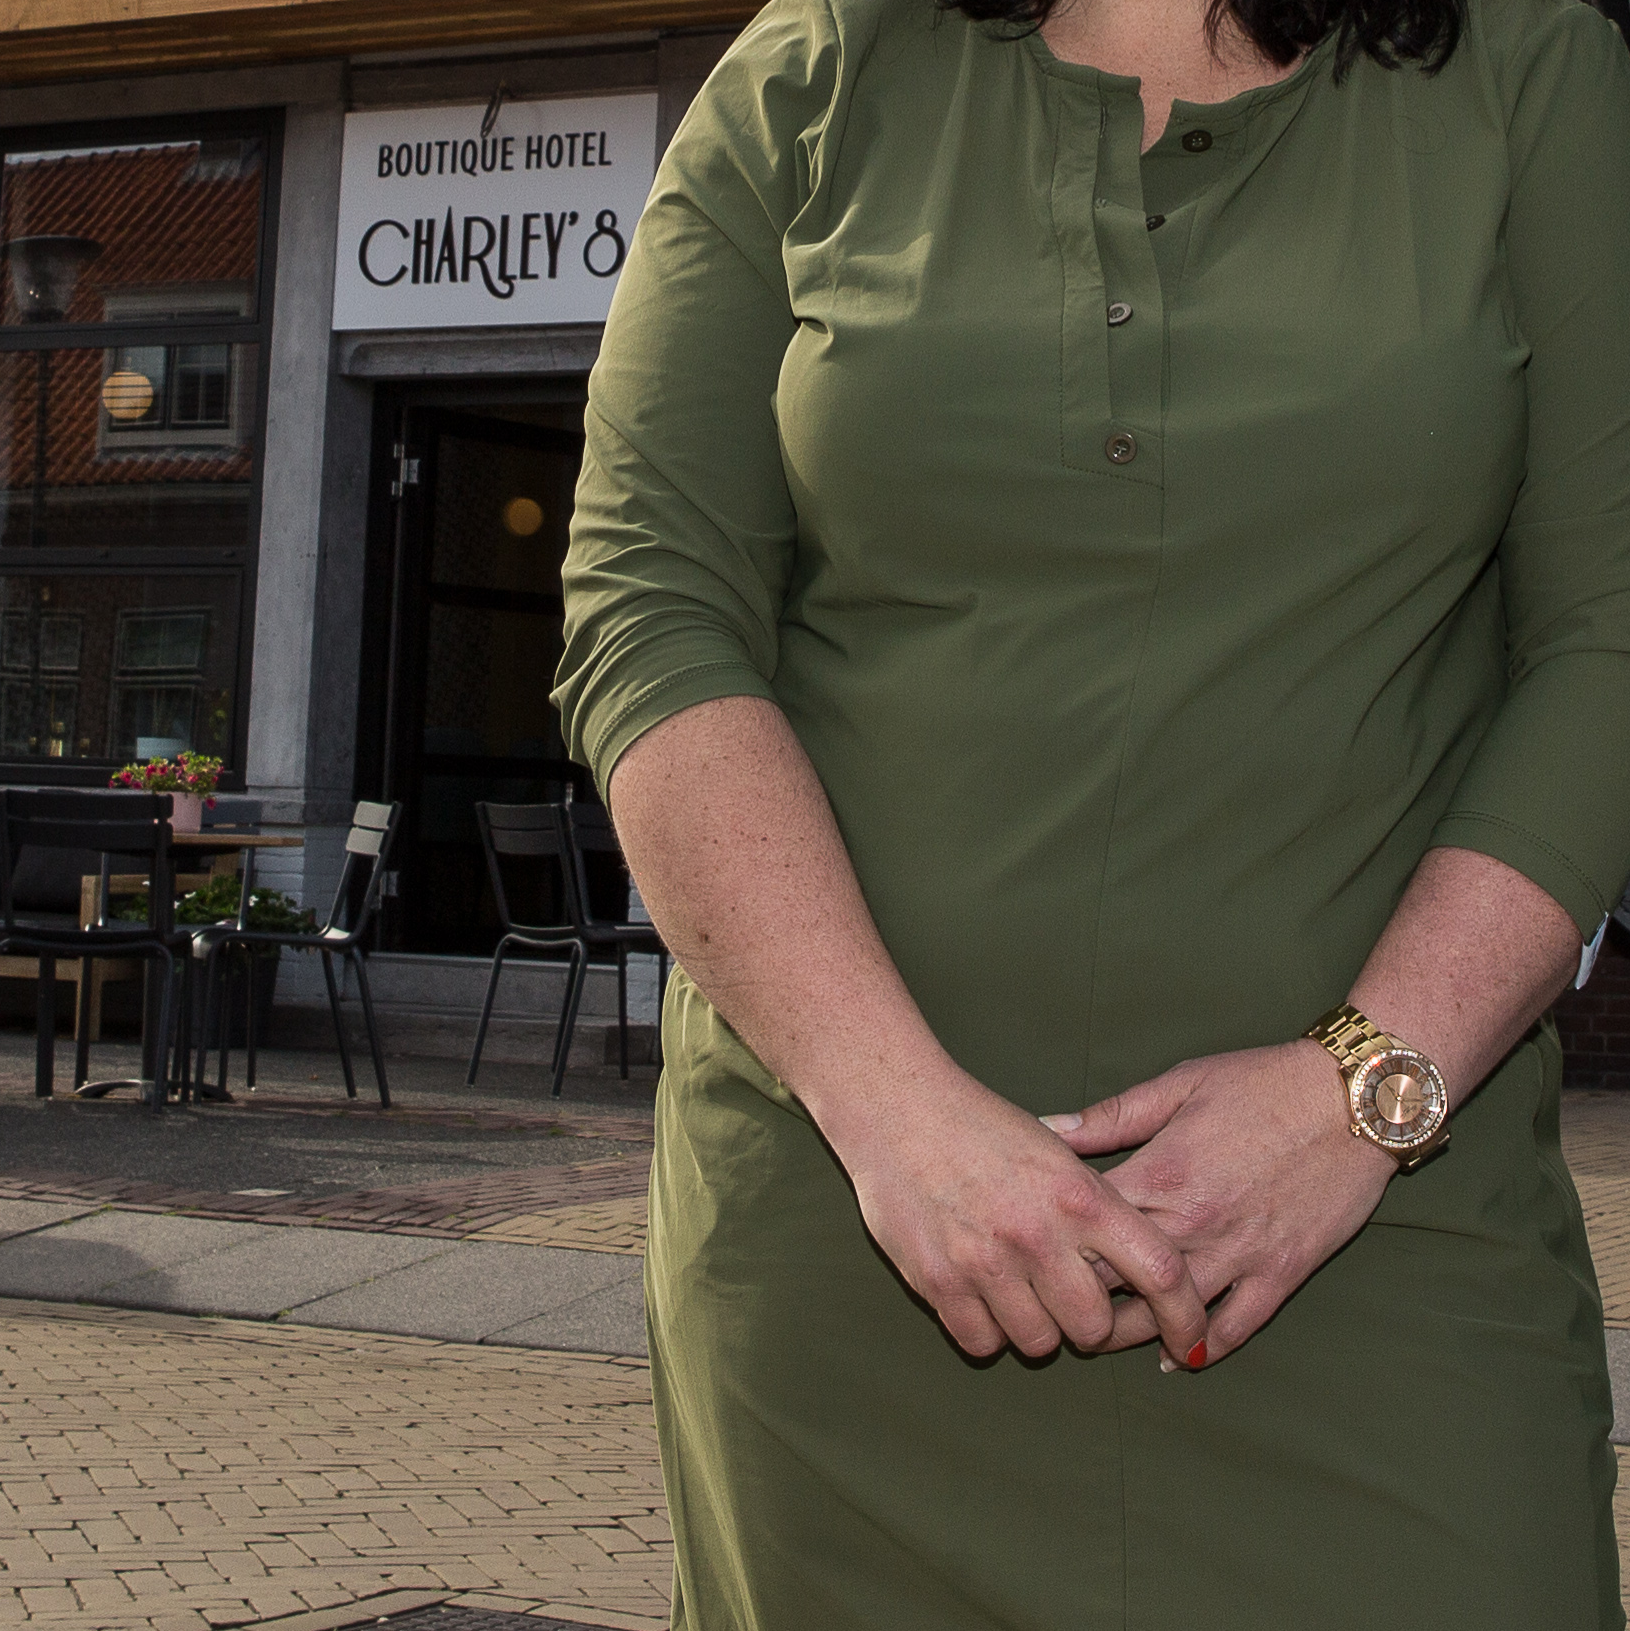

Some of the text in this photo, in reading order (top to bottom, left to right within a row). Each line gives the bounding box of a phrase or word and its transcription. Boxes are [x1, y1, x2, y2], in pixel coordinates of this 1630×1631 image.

[377, 130, 613, 179] BOUTIQUE HOTEL
[357, 205, 627, 300] CHARLEY'S
